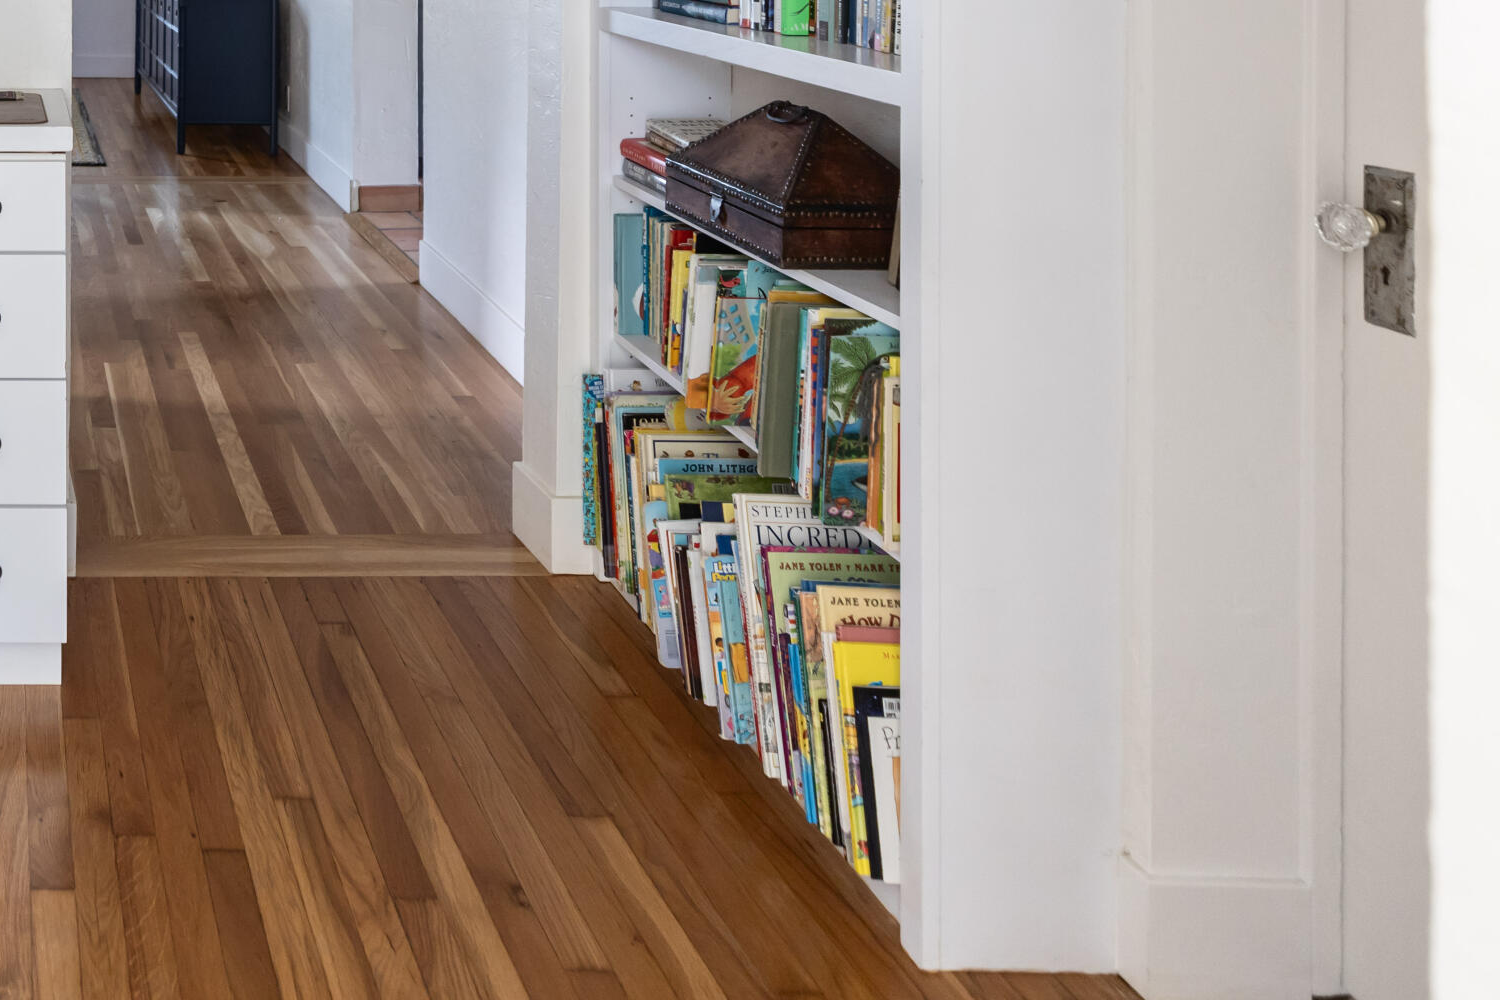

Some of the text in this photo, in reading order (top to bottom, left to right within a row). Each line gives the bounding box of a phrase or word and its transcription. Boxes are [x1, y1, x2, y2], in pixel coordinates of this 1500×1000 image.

[682, 464, 713, 473] JOHN
[779, 562, 841, 571] JANE YOLEN
[855, 563, 884, 572] MARK
[831, 597, 859, 606] JANE
